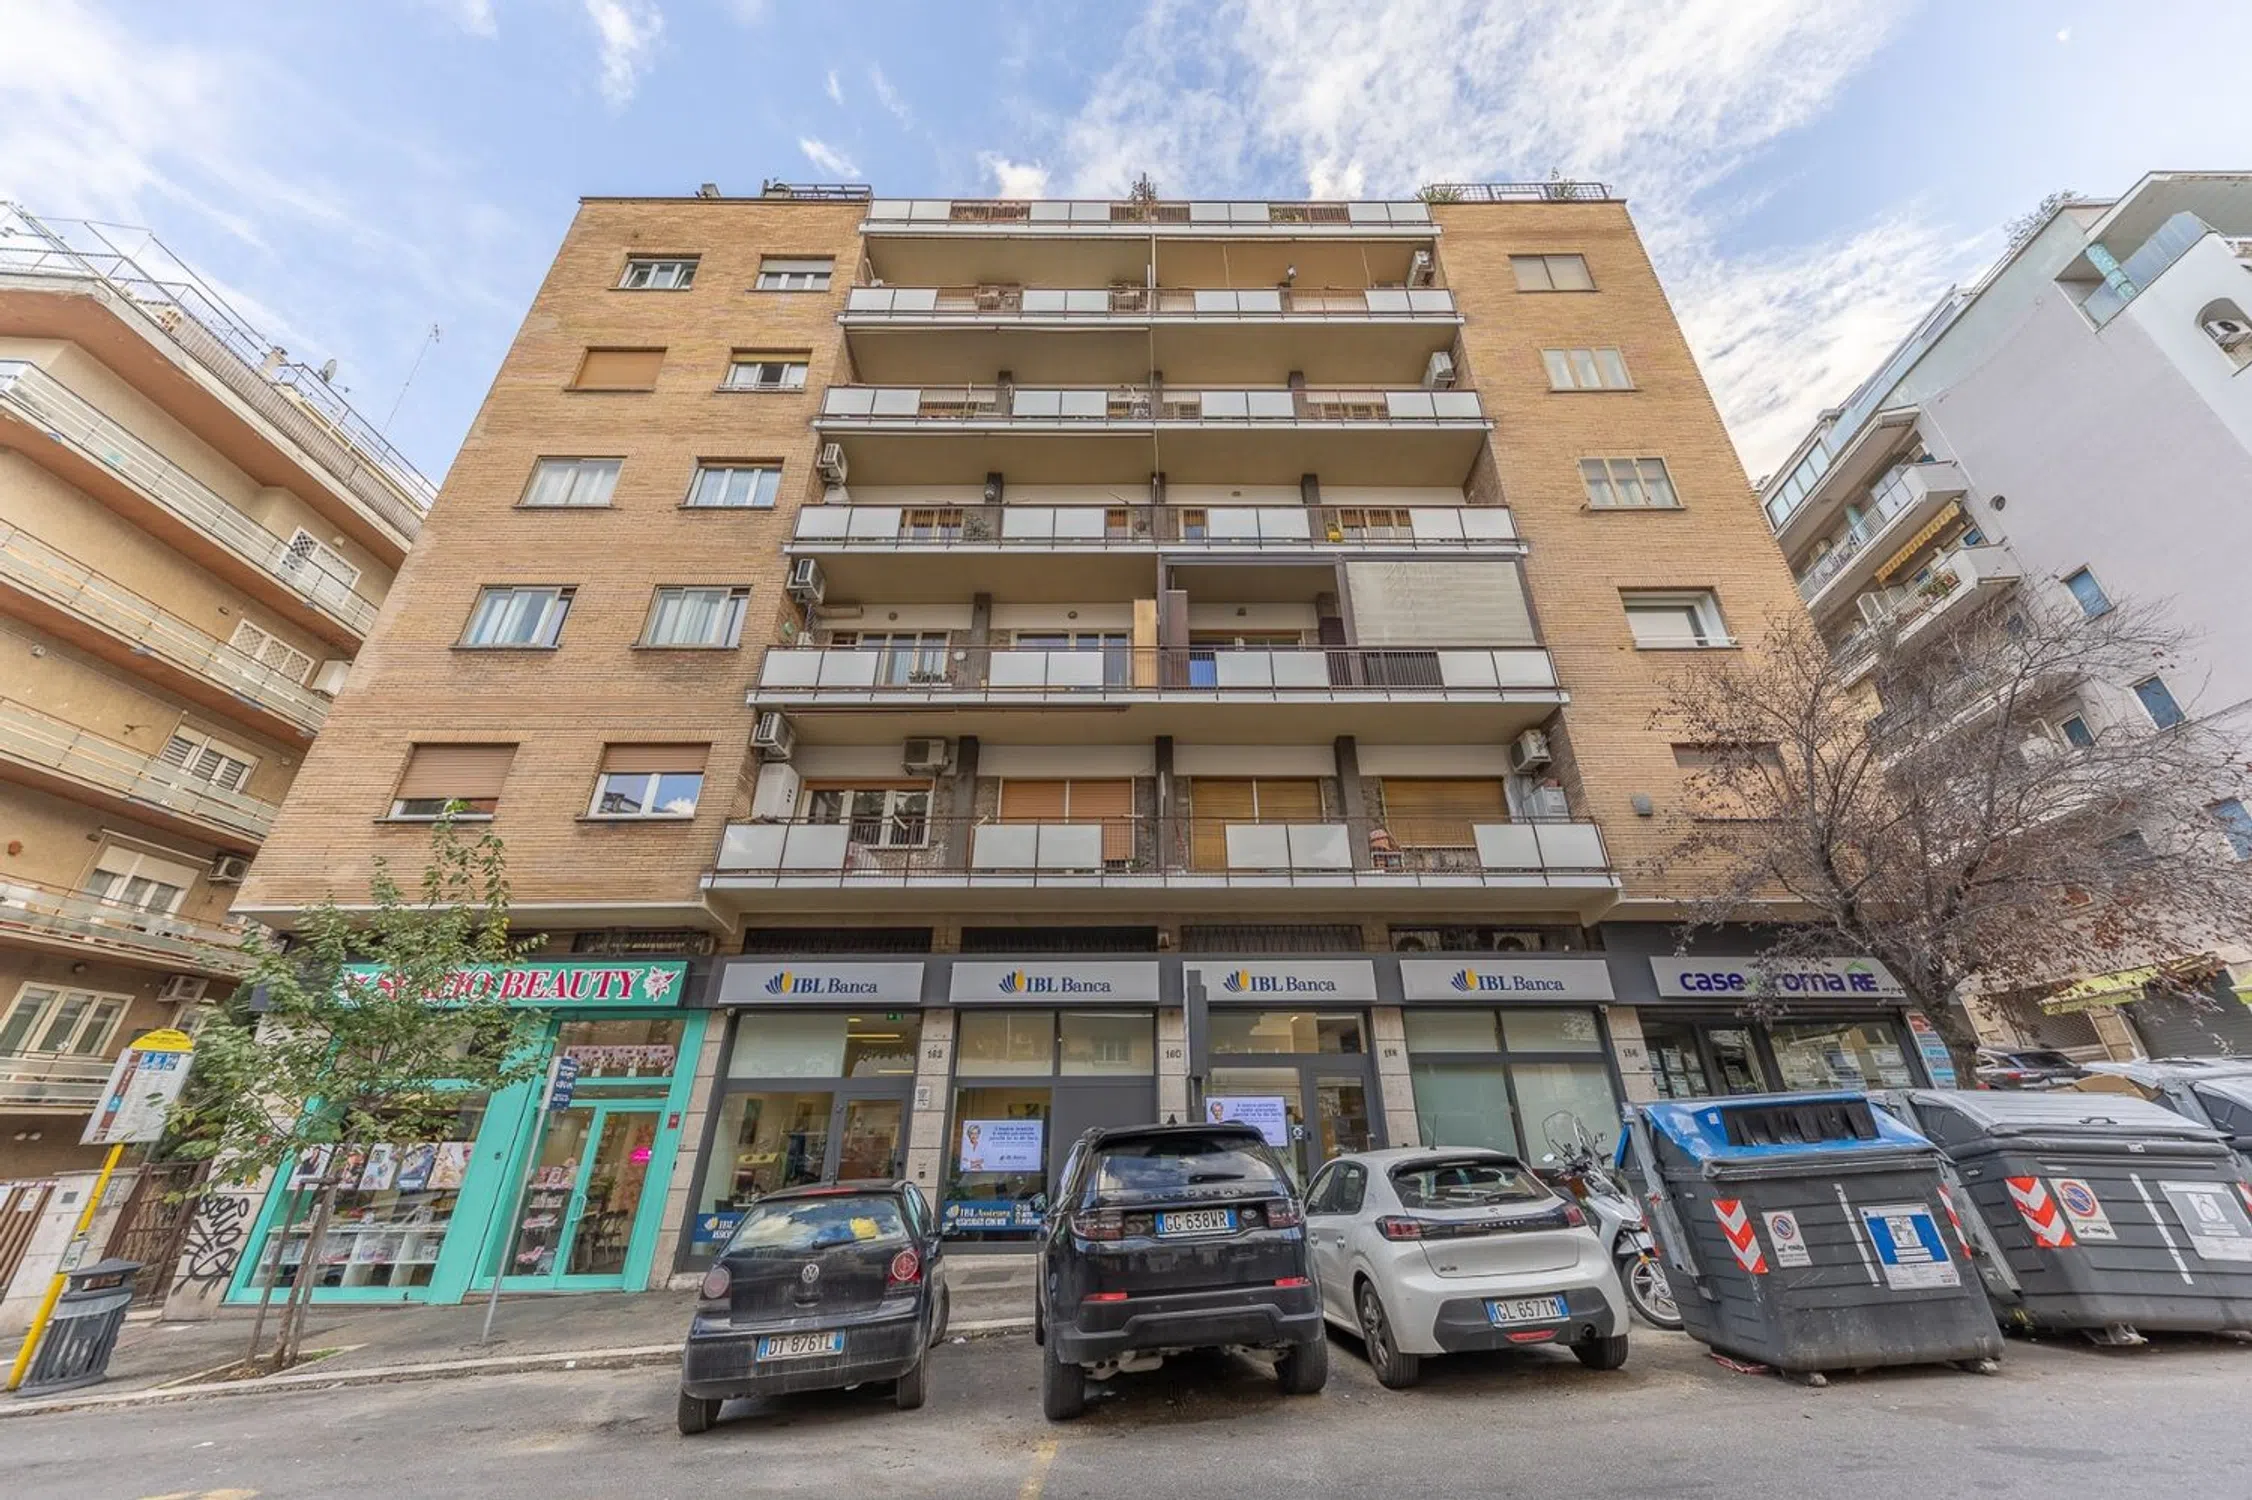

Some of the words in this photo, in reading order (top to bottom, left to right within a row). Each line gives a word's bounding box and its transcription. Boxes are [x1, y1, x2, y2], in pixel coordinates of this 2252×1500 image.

[498, 970, 643, 999] BEAUTY
[792, 977, 825, 994] IBL
[827, 977, 878, 994] Banca
[1026, 976, 1059, 993] IBL
[1061, 976, 1111, 993] Banca
[1250, 976, 1283, 992] IBL
[1285, 975, 1337, 992] Banca
[1477, 975, 1512, 991] IBL
[1512, 975, 1565, 991] Banca
[1165, 1214, 1181, 1231] GG
[1185, 1210, 1227, 1229] 638WR
[1496, 1301, 1516, 1320] GL
[1519, 1296, 1560, 1318] 657TM
[768, 1337, 787, 1355] DT
[791, 1333, 833, 1353] 876TL
